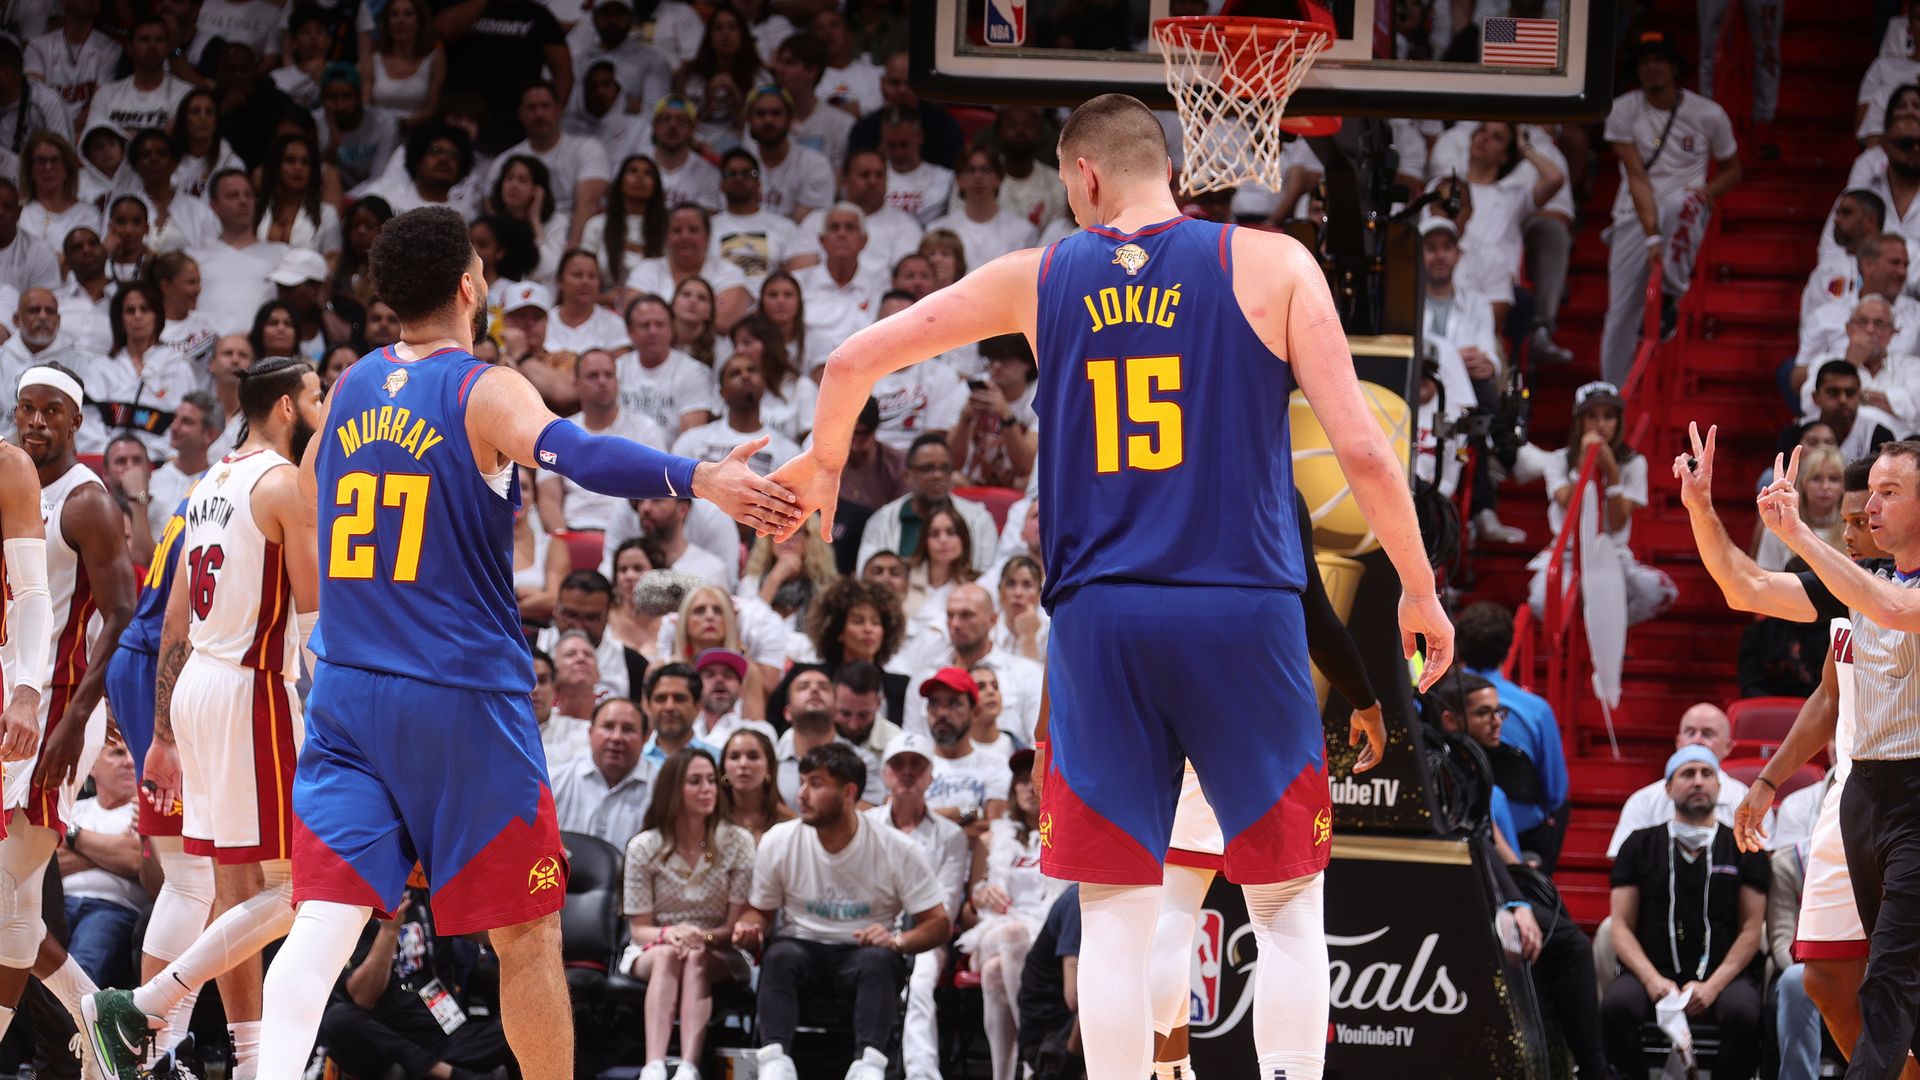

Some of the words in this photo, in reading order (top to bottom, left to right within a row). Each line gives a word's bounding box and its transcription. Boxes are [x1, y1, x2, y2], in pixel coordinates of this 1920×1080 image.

[991, 24, 1010, 39] NBA
[1083, 283, 1182, 333] JOKIĆ
[336, 405, 444, 461] MURRAY
[1085, 353, 1184, 474] 15
[189, 496, 234, 531] MARTIN
[328, 470, 432, 583] 27
[188, 544, 225, 623] 16
[1190, 925, 1469, 1039] Fnals
